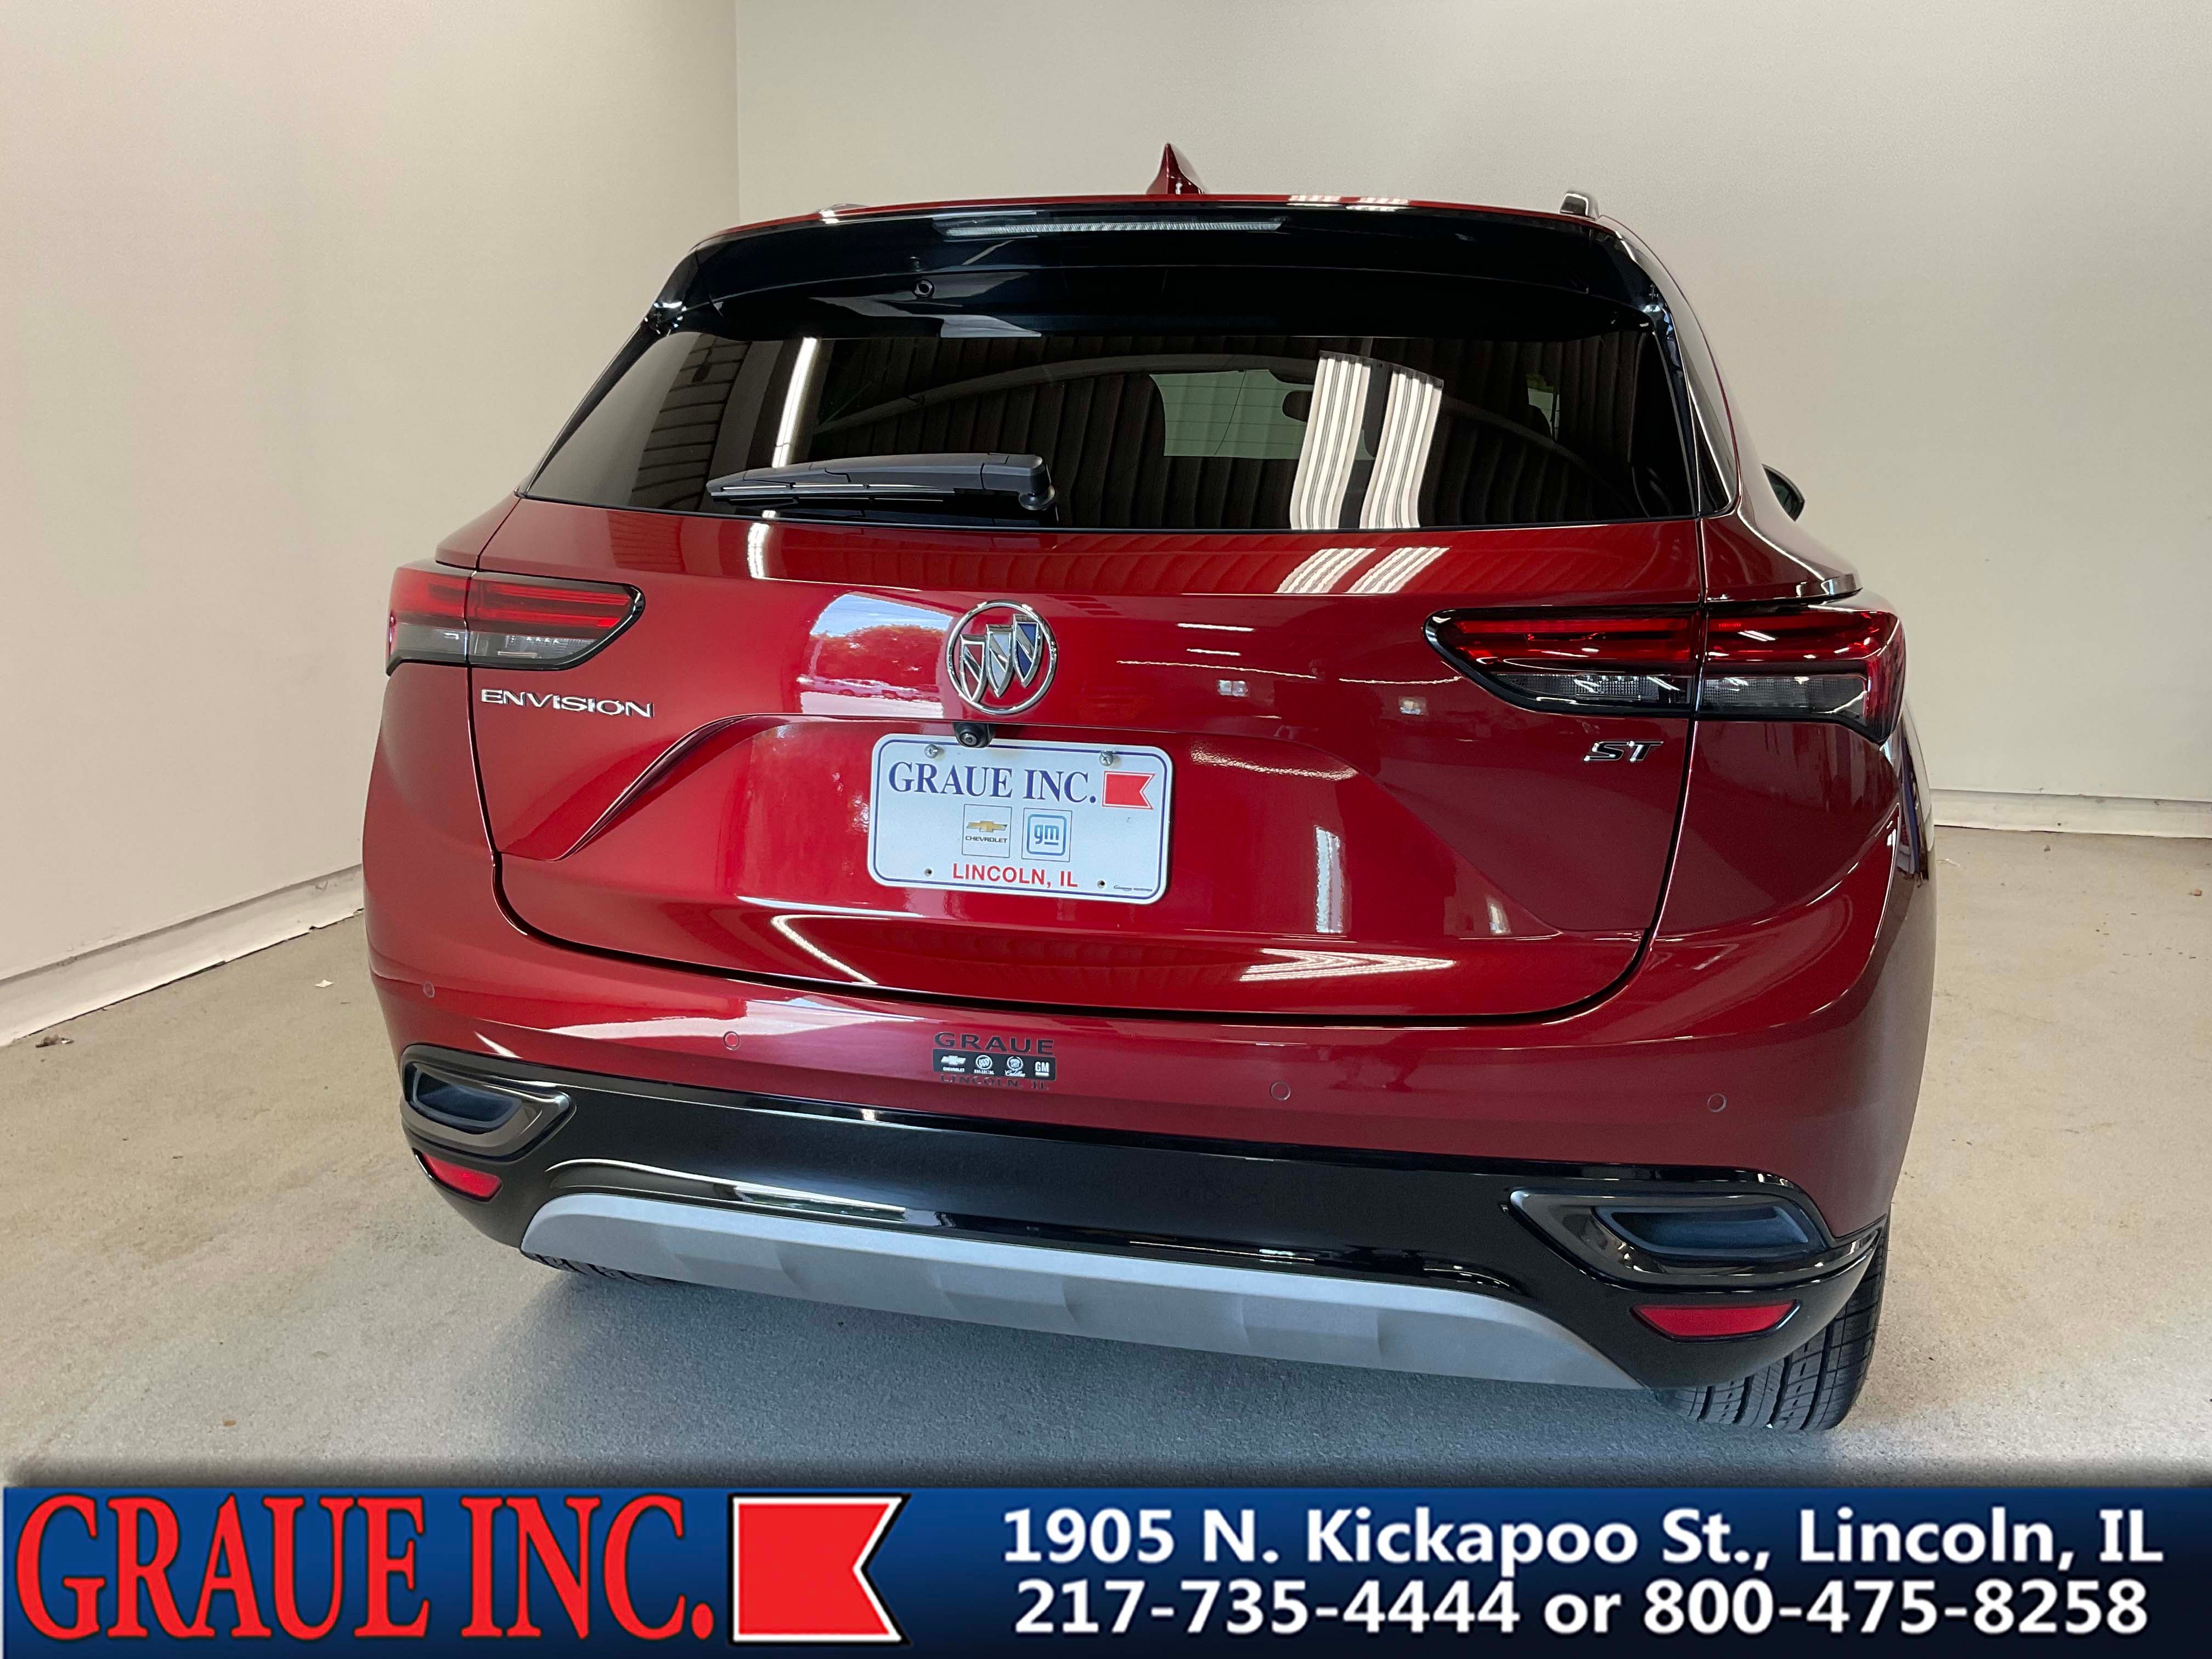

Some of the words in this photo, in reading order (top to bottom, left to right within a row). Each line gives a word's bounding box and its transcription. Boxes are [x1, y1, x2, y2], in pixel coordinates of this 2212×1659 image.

[481, 688, 654, 718] ENVISION
[1583, 741, 1664, 763] ST
[888, 761, 1013, 798] GRAUE
[1022, 769, 1096, 804] INC.
[965, 834, 1008, 844] CHEVROLET
[1034, 824, 1059, 845] gm
[952, 862, 1051, 888] LINCOLN,
[1059, 871, 1079, 888] IL
[934, 1031, 1054, 1055] GRAUE
[1035, 1061, 1049, 1073] GM
